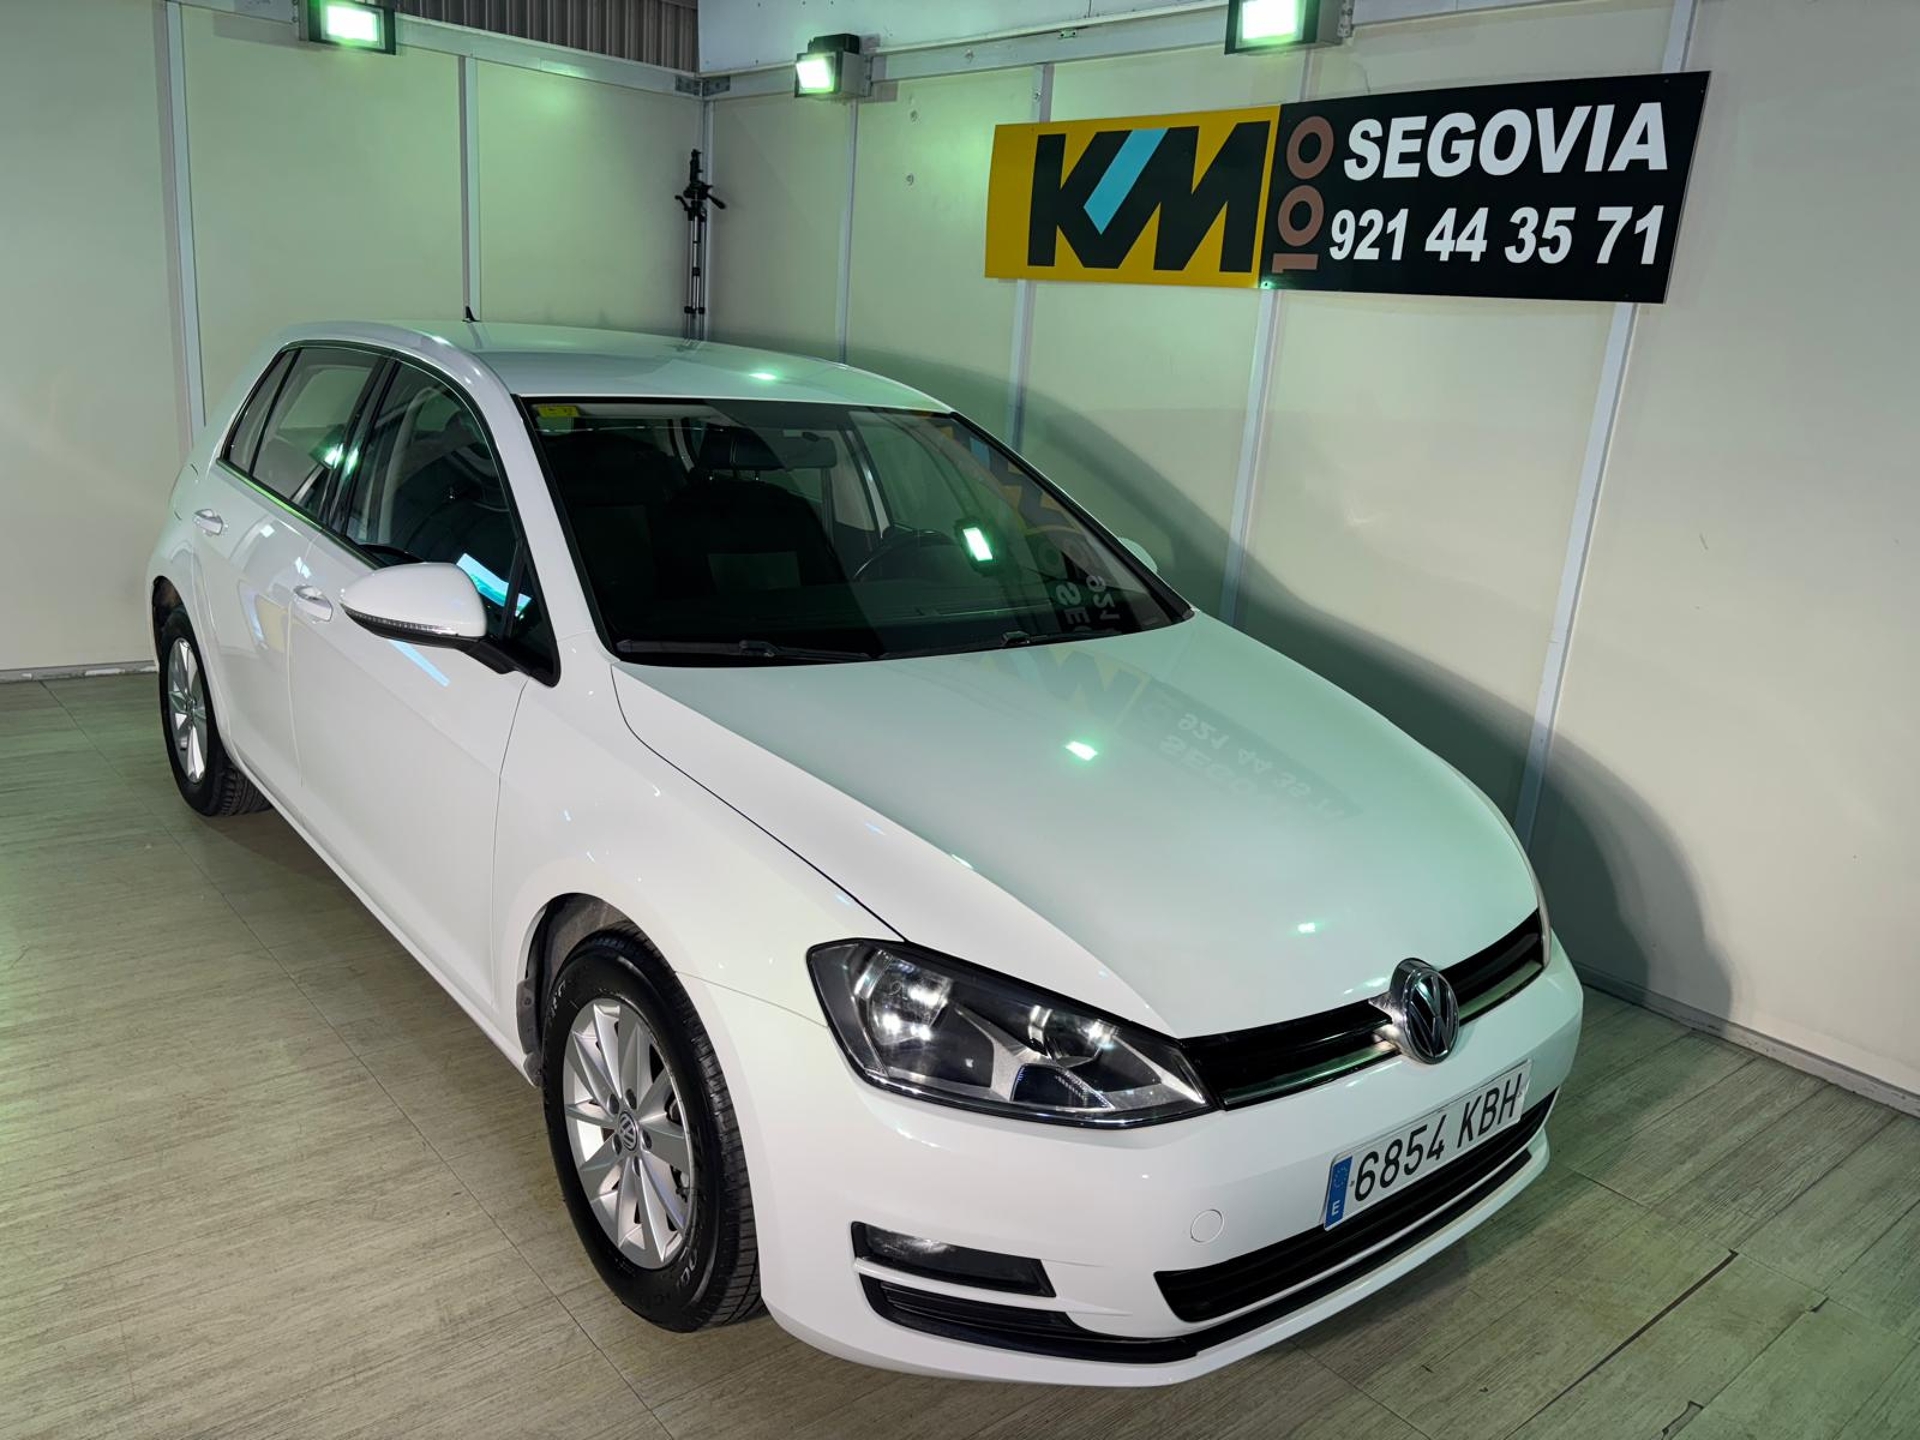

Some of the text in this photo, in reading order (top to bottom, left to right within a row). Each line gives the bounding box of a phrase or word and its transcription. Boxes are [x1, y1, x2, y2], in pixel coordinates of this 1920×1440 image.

[1343, 102, 1669, 183] SEGOVIA
[1027, 120, 1271, 272] KM
[1329, 204, 1666, 265] 921 44 35 71
[1354, 1073, 1523, 1201] 6854 KBH
[1331, 1201, 1340, 1216] E
